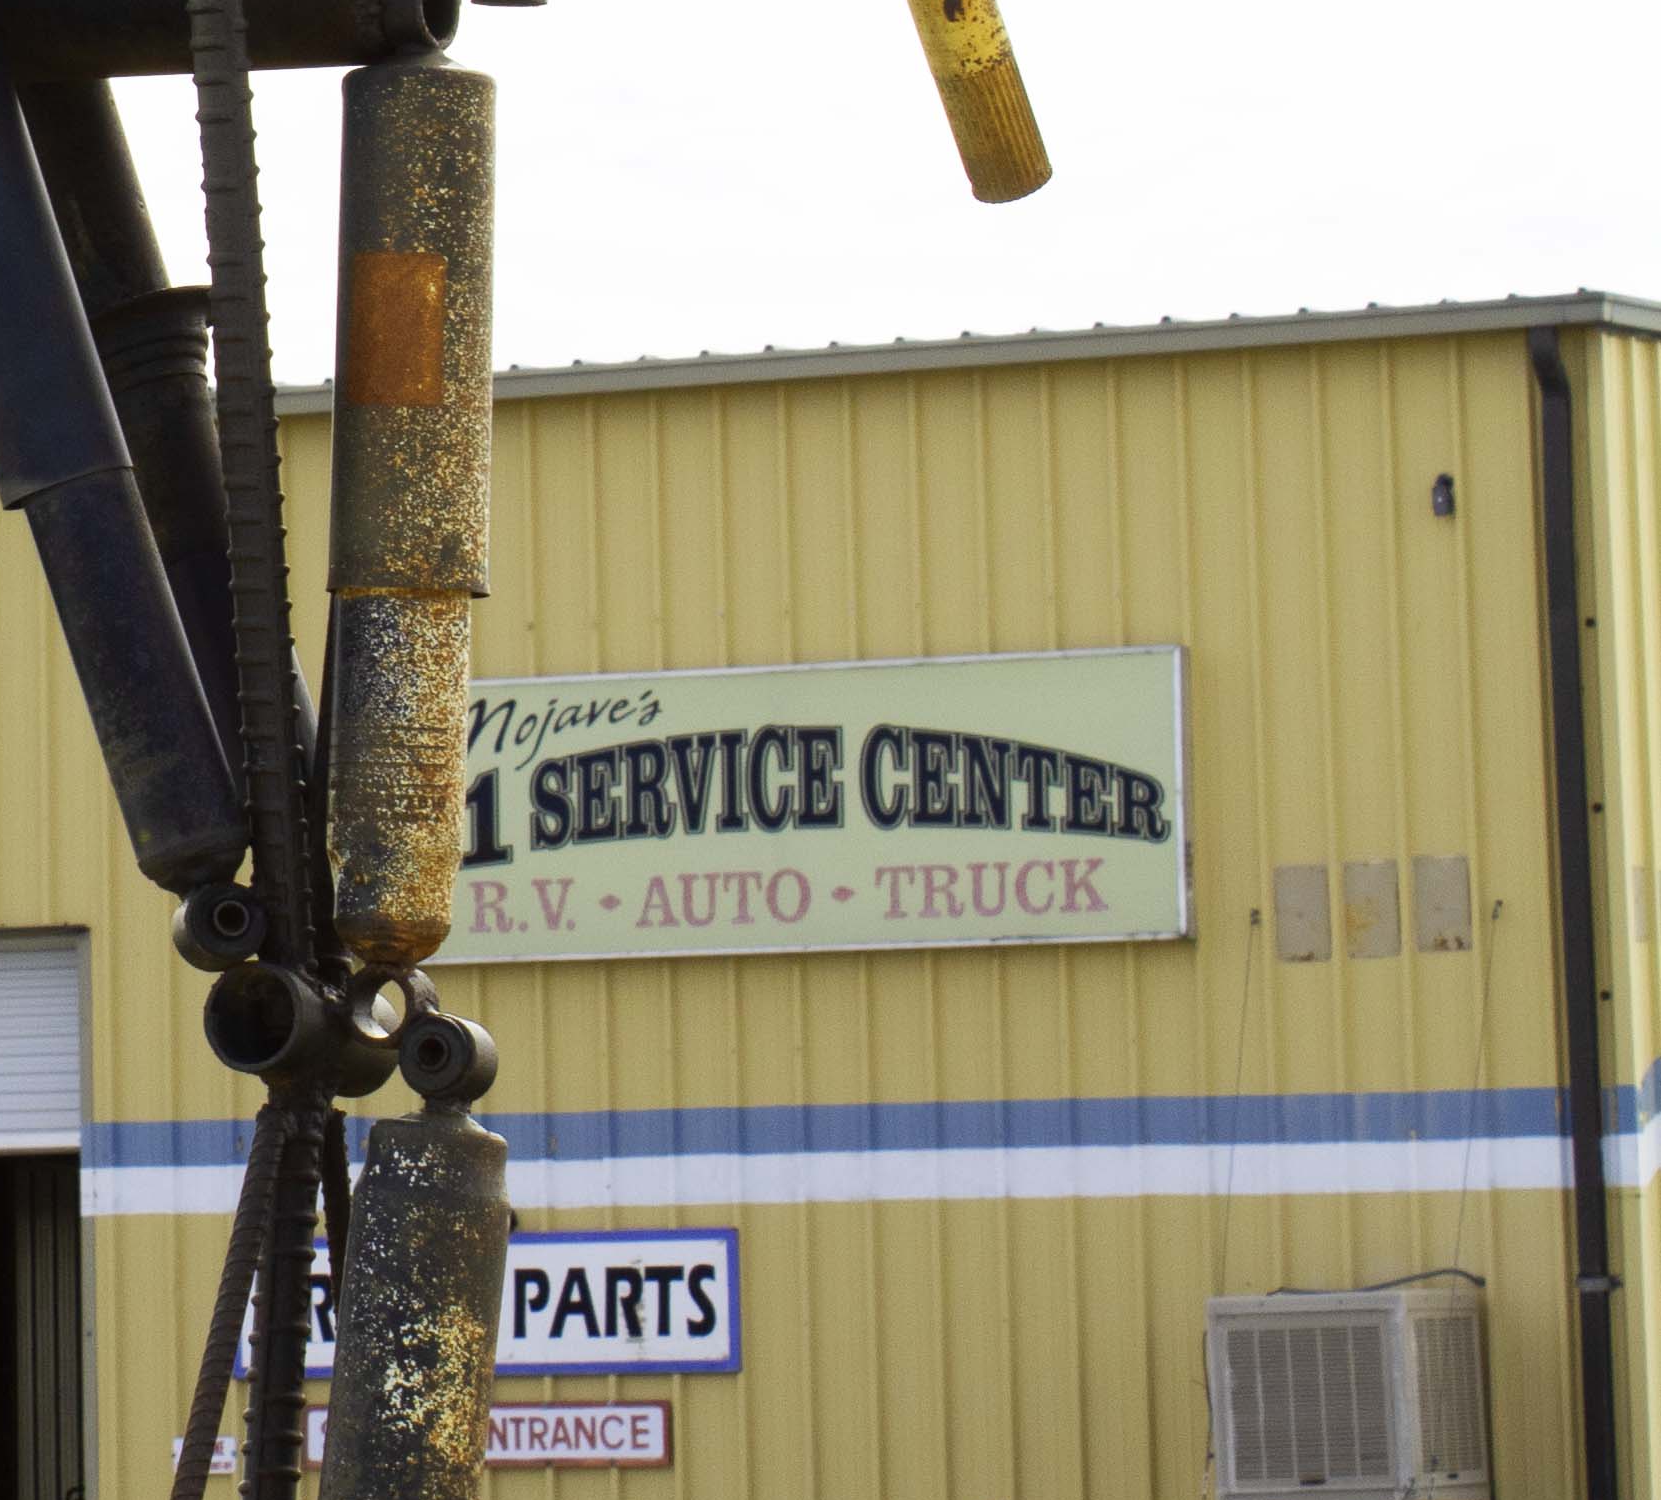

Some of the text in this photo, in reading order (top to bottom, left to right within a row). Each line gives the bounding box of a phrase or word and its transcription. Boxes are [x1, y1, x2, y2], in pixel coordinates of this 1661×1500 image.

[529, 724, 844, 852] SERVICE
[859, 723, 1172, 843] CENTER
[468, 857, 1109, 934] R.V. AUTO TRUCK
[513, 1264, 716, 1338] PARTS
